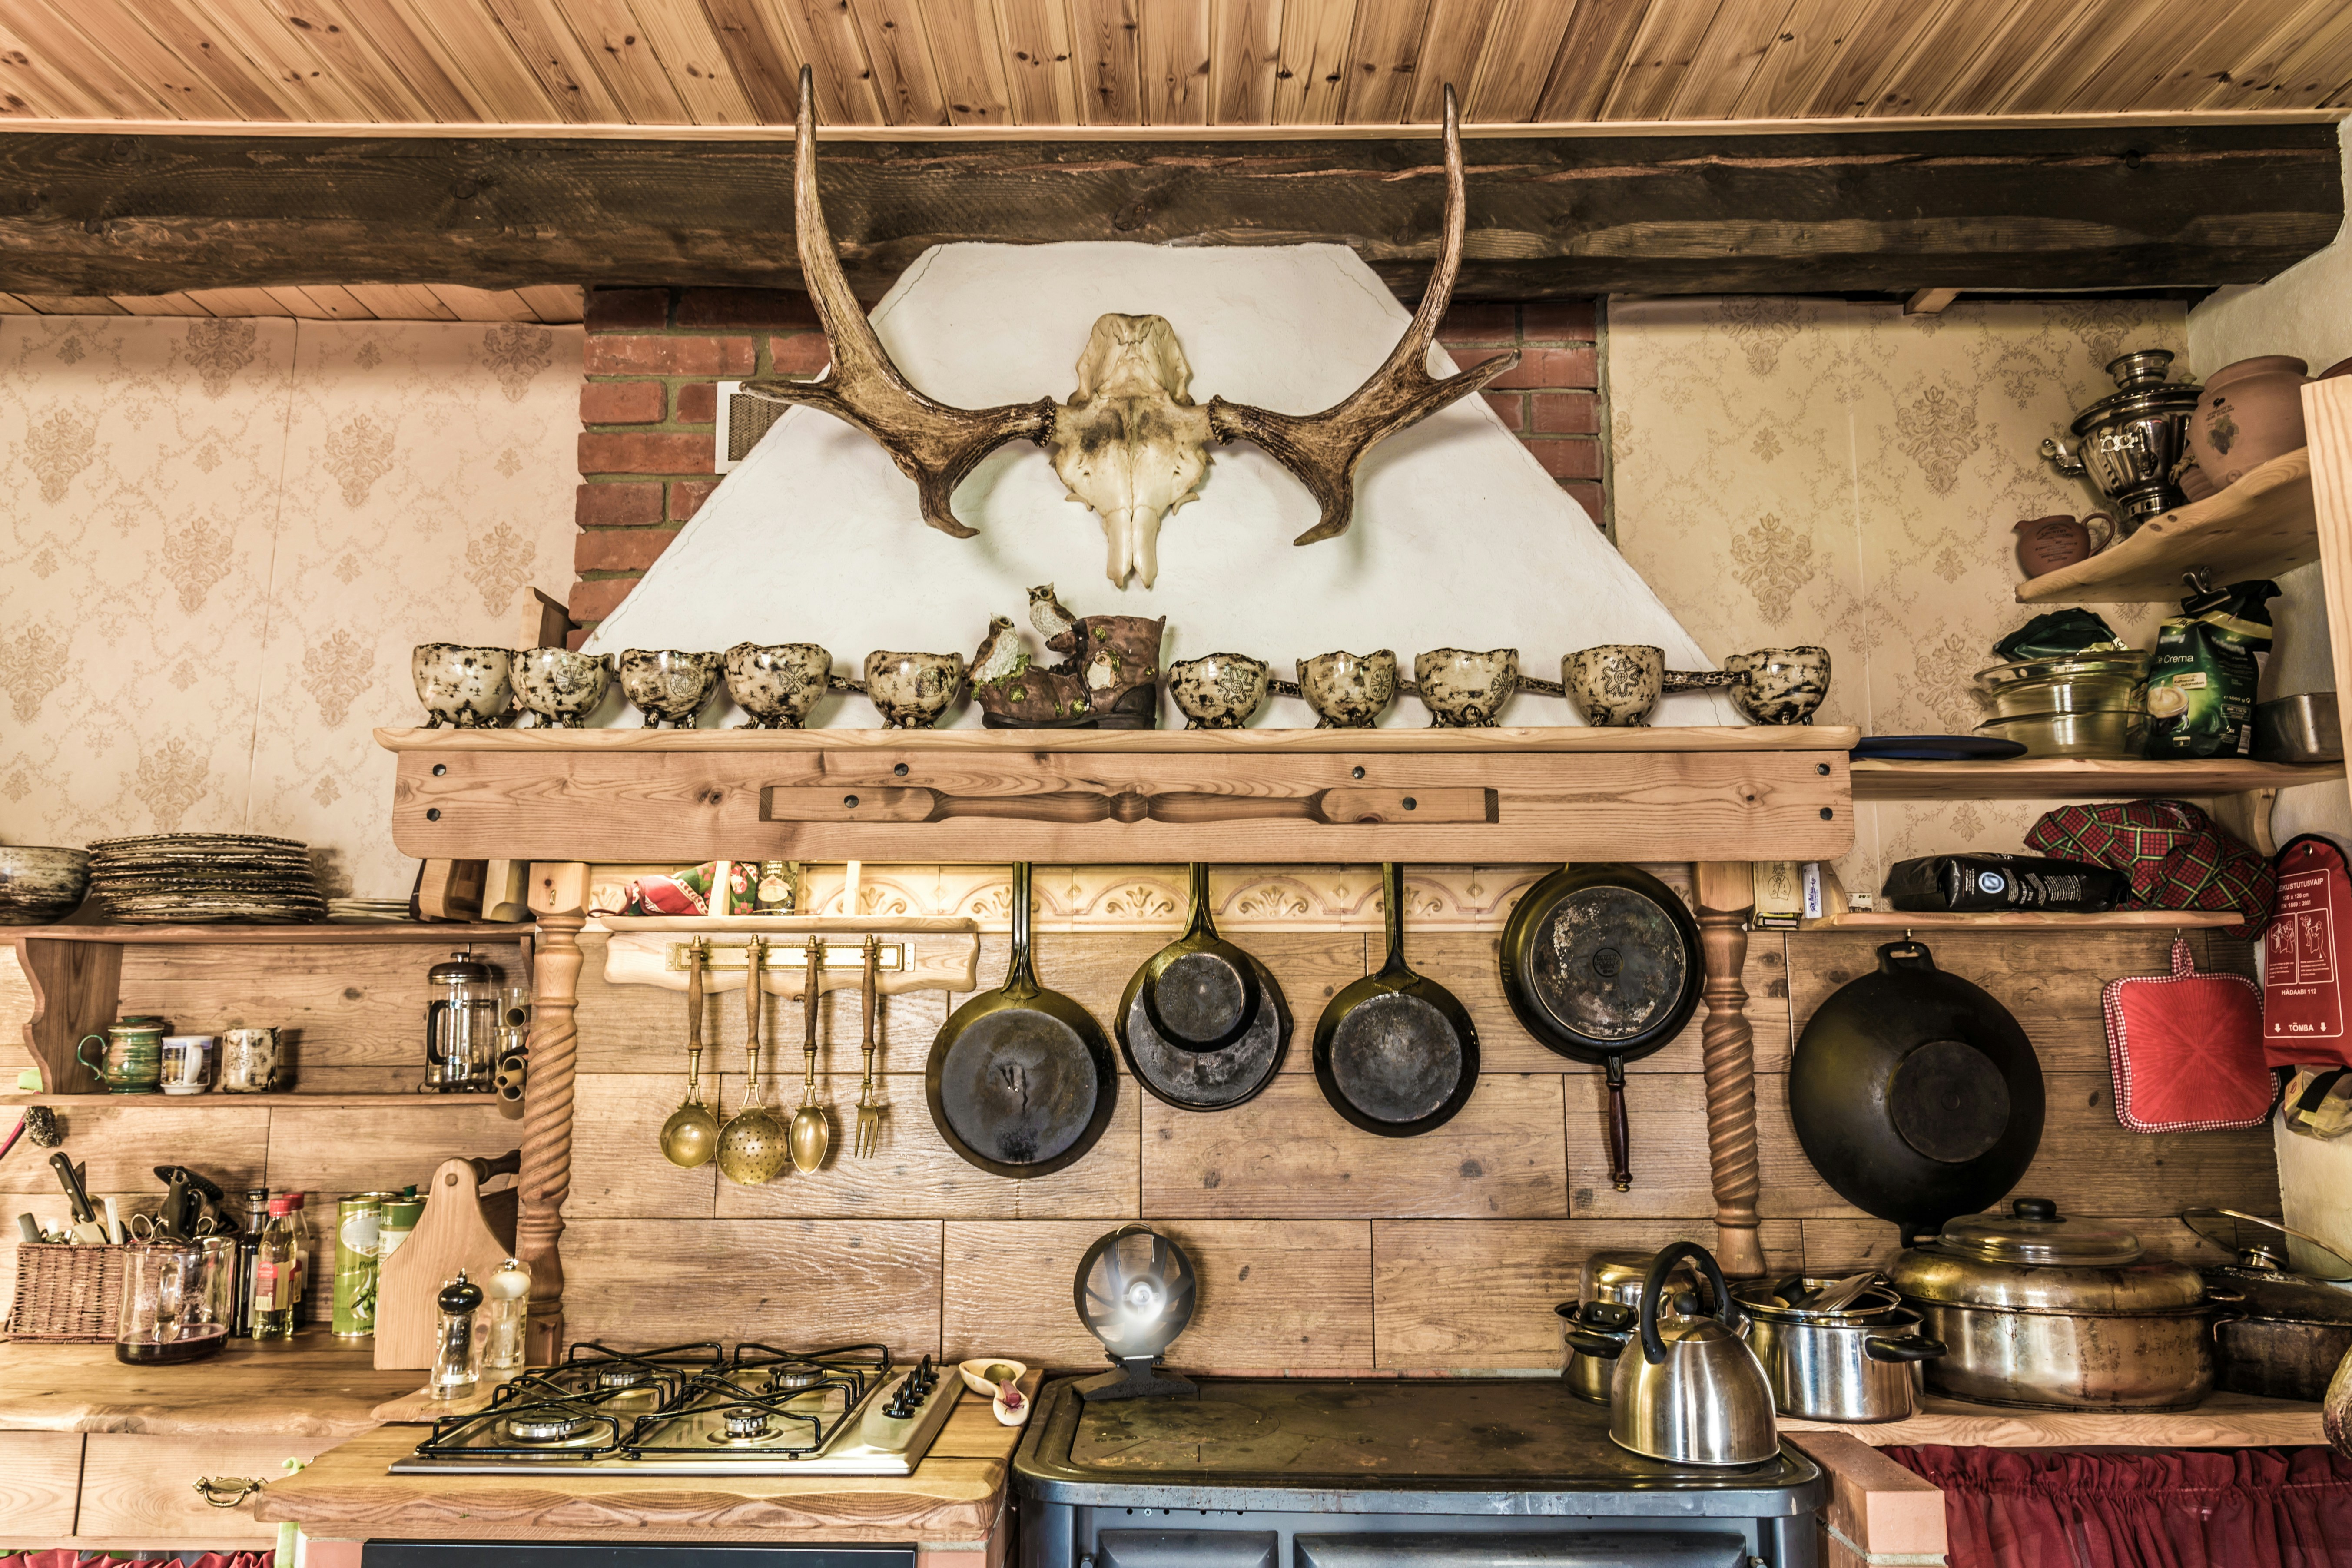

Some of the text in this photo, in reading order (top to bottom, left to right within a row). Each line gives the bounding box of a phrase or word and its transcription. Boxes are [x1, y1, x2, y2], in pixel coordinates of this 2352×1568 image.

[2164, 655, 2194, 663] Crema
[2289, 1022, 2314, 1031] TÕMBA
[338, 1259, 378, 1273] Olive Pom
